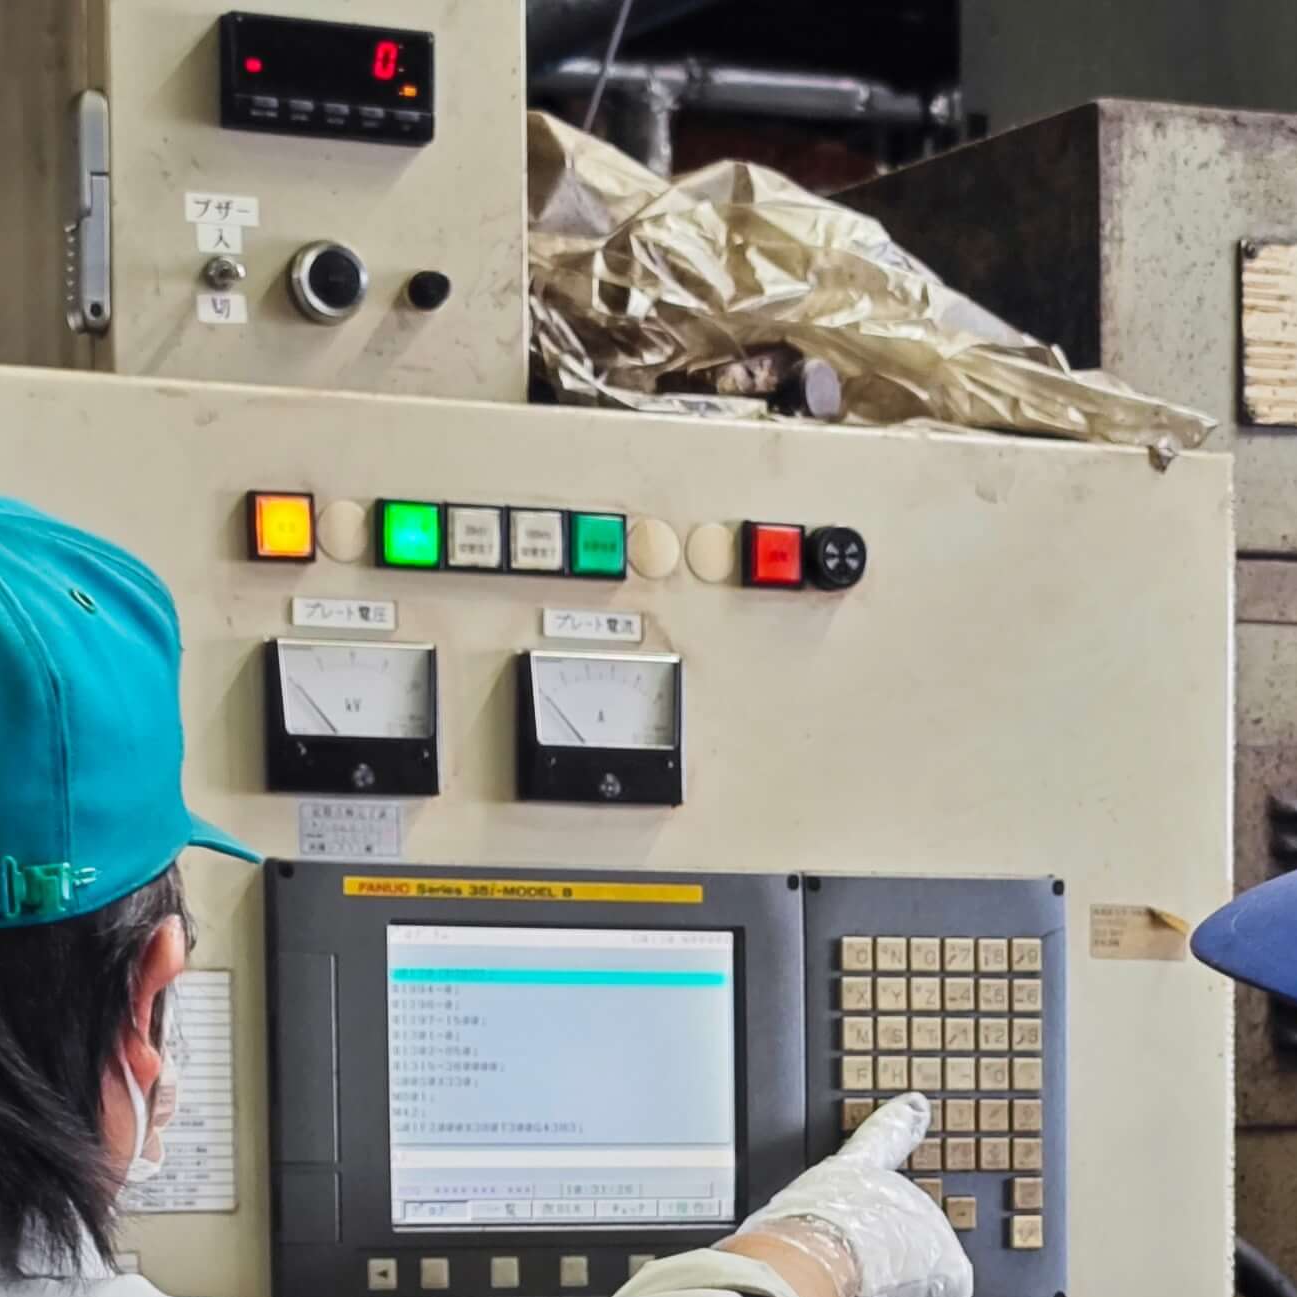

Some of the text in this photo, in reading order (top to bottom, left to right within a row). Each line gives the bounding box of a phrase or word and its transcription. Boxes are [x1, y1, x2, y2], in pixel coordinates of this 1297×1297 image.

[373, 39, 399, 81] 0
[193, 197, 251, 220] ブザー
[212, 227, 231, 249] 入
[211, 296, 231, 319] 切
[304, 602, 388, 623] プレート電圧
[357, 881, 409, 896] FANUC
[416, 882, 463, 897] Series
